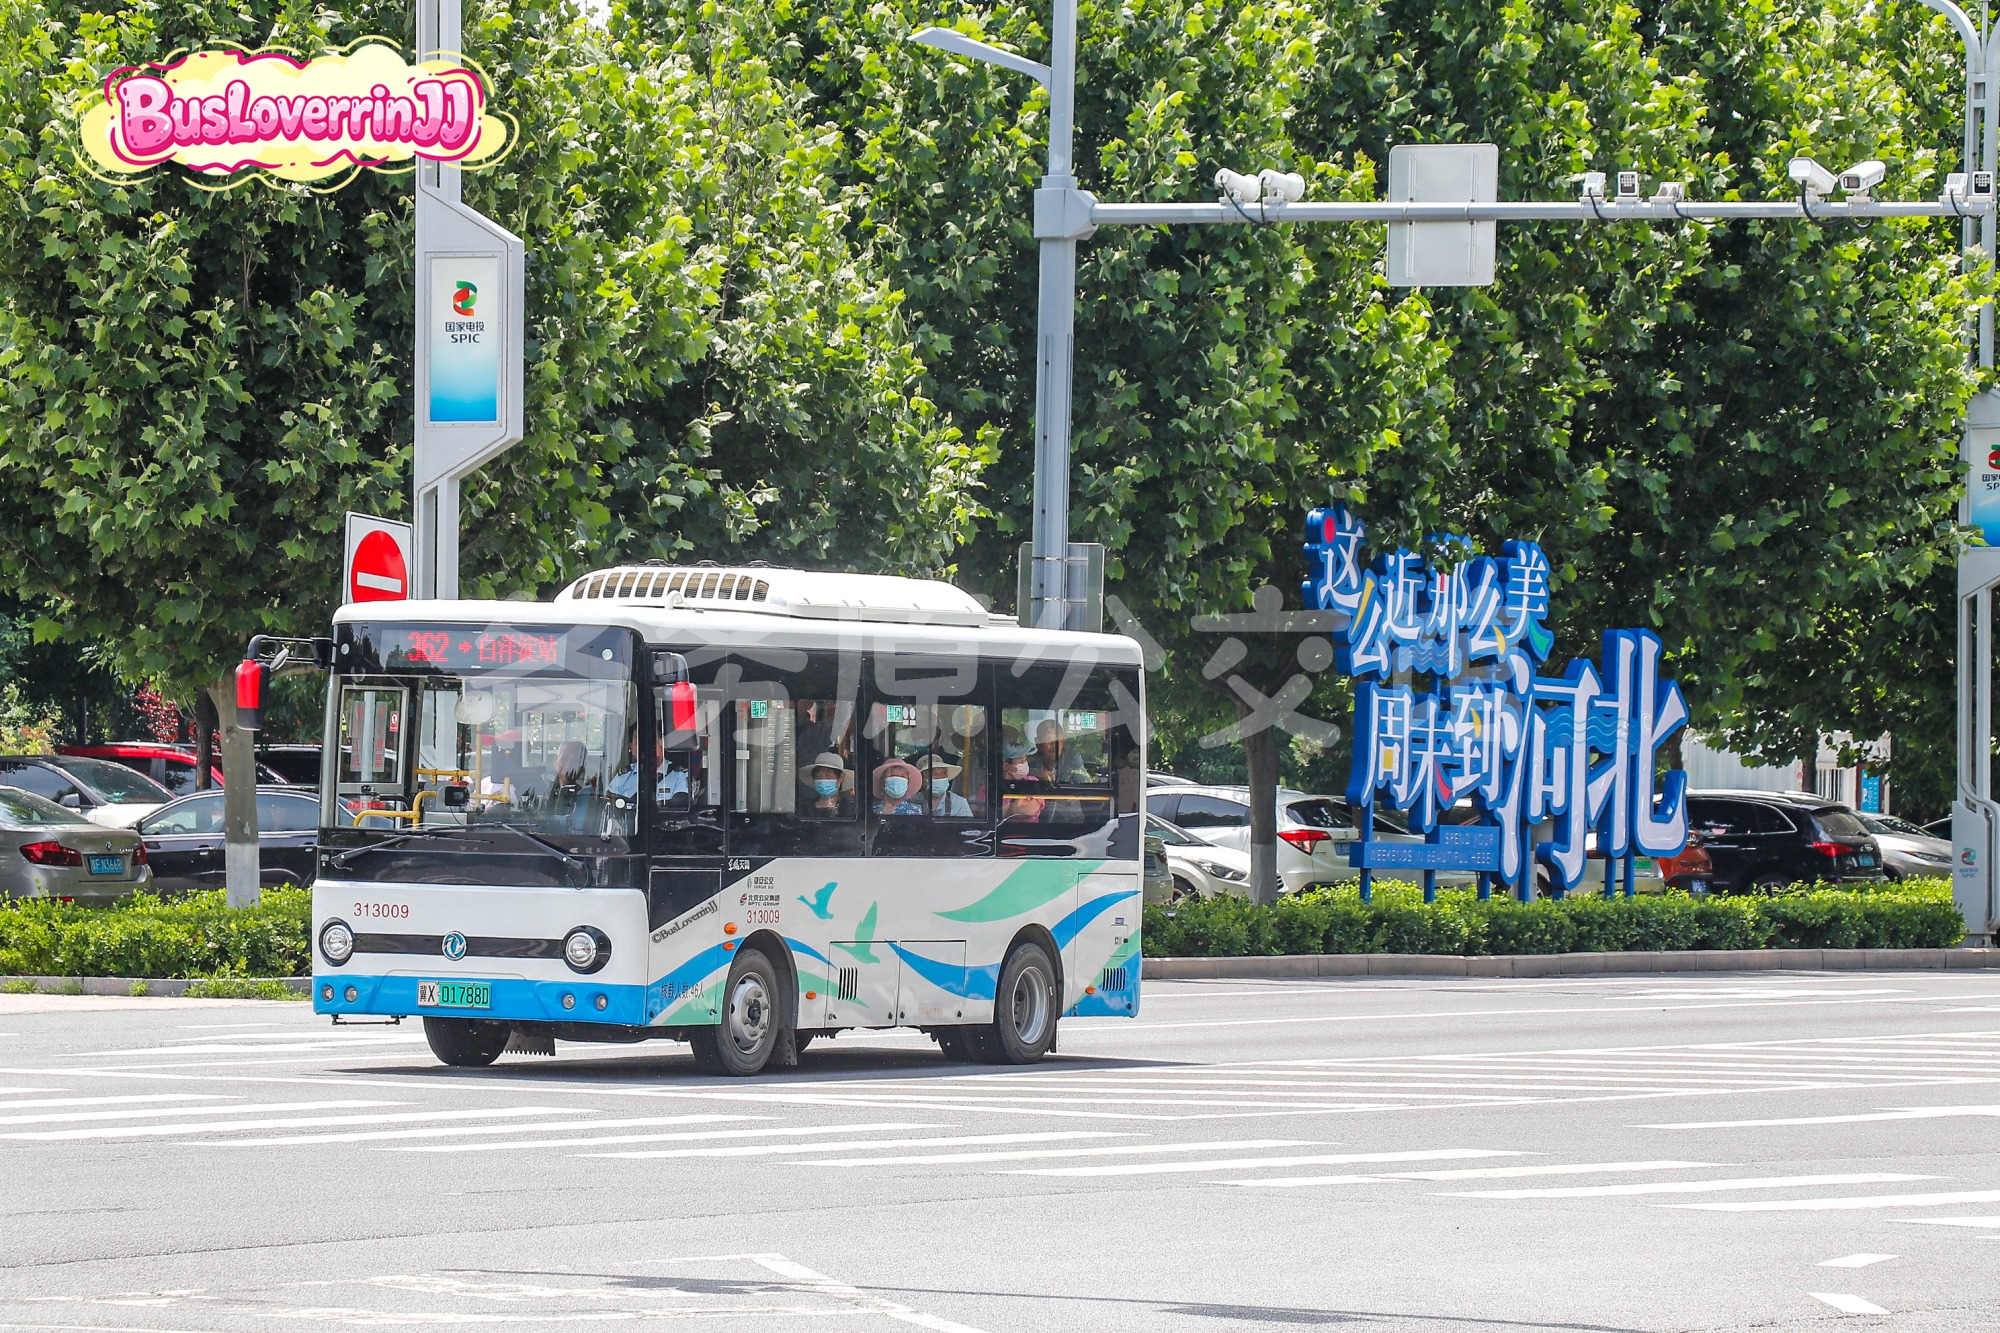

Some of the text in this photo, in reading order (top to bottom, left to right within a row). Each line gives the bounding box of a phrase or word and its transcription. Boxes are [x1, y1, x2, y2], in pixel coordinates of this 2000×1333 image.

[445, 321, 485, 332] 国家电投
[450, 333, 480, 344] SPIC
[1982, 473, 2000, 482] 国家
[408, 632, 559, 663] 362 白洋淀站
[1360, 625, 1688, 886] 周末到河北
[353, 902, 409, 919] 313009
[746, 909, 780, 924] 313009
